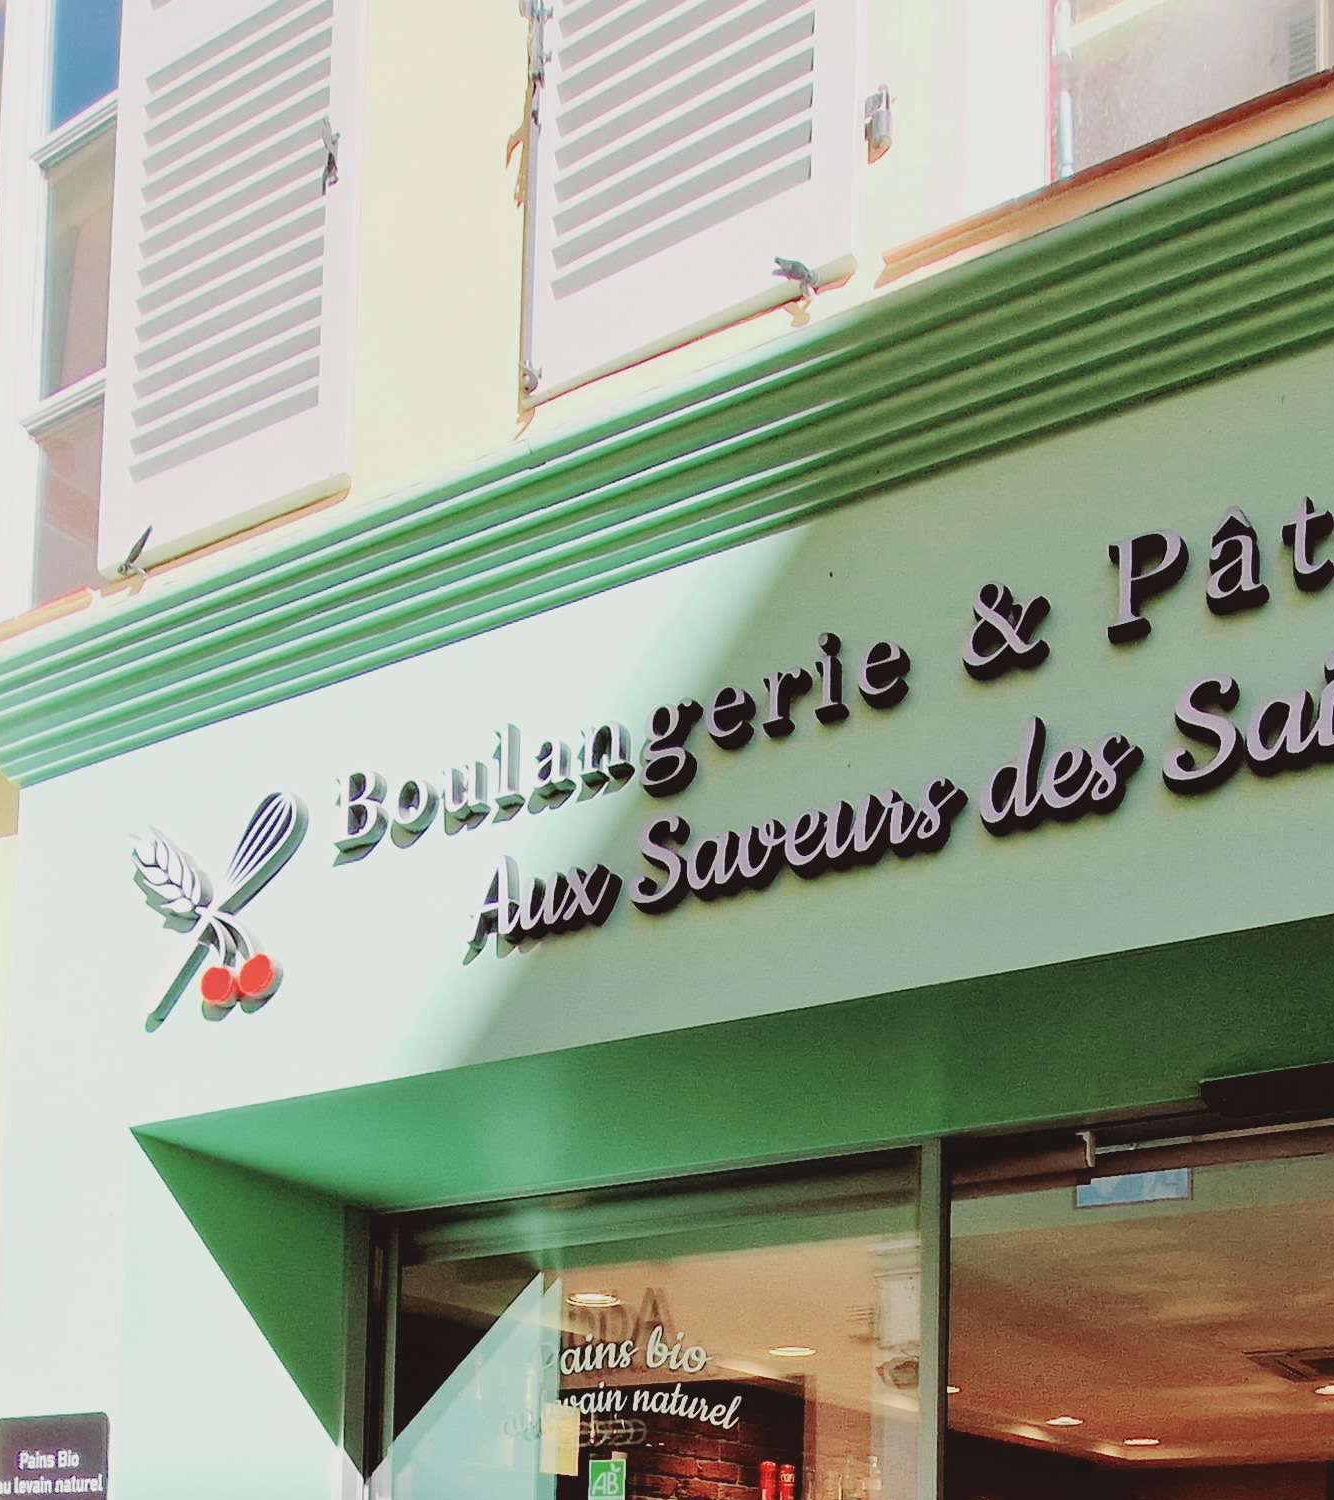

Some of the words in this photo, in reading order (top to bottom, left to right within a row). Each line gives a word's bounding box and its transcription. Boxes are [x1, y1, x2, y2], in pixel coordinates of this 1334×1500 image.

[333, 630, 912, 866] Boulangerie
[961, 581, 1051, 679] &
[466, 822, 622, 962] Aux
[631, 771, 968, 912] Saveurs
[977, 717, 1142, 834] des
[647, 1326, 713, 1373] bio
[633, 1382, 742, 1430] naturel
[18, 1450, 55, 1470] Pains
[58, 1450, 79, 1468] Bio
[592, 1472, 619, 1495] AB
[13, 1476, 52, 1495] levain
[54, 1473, 104, 1493] naturel
